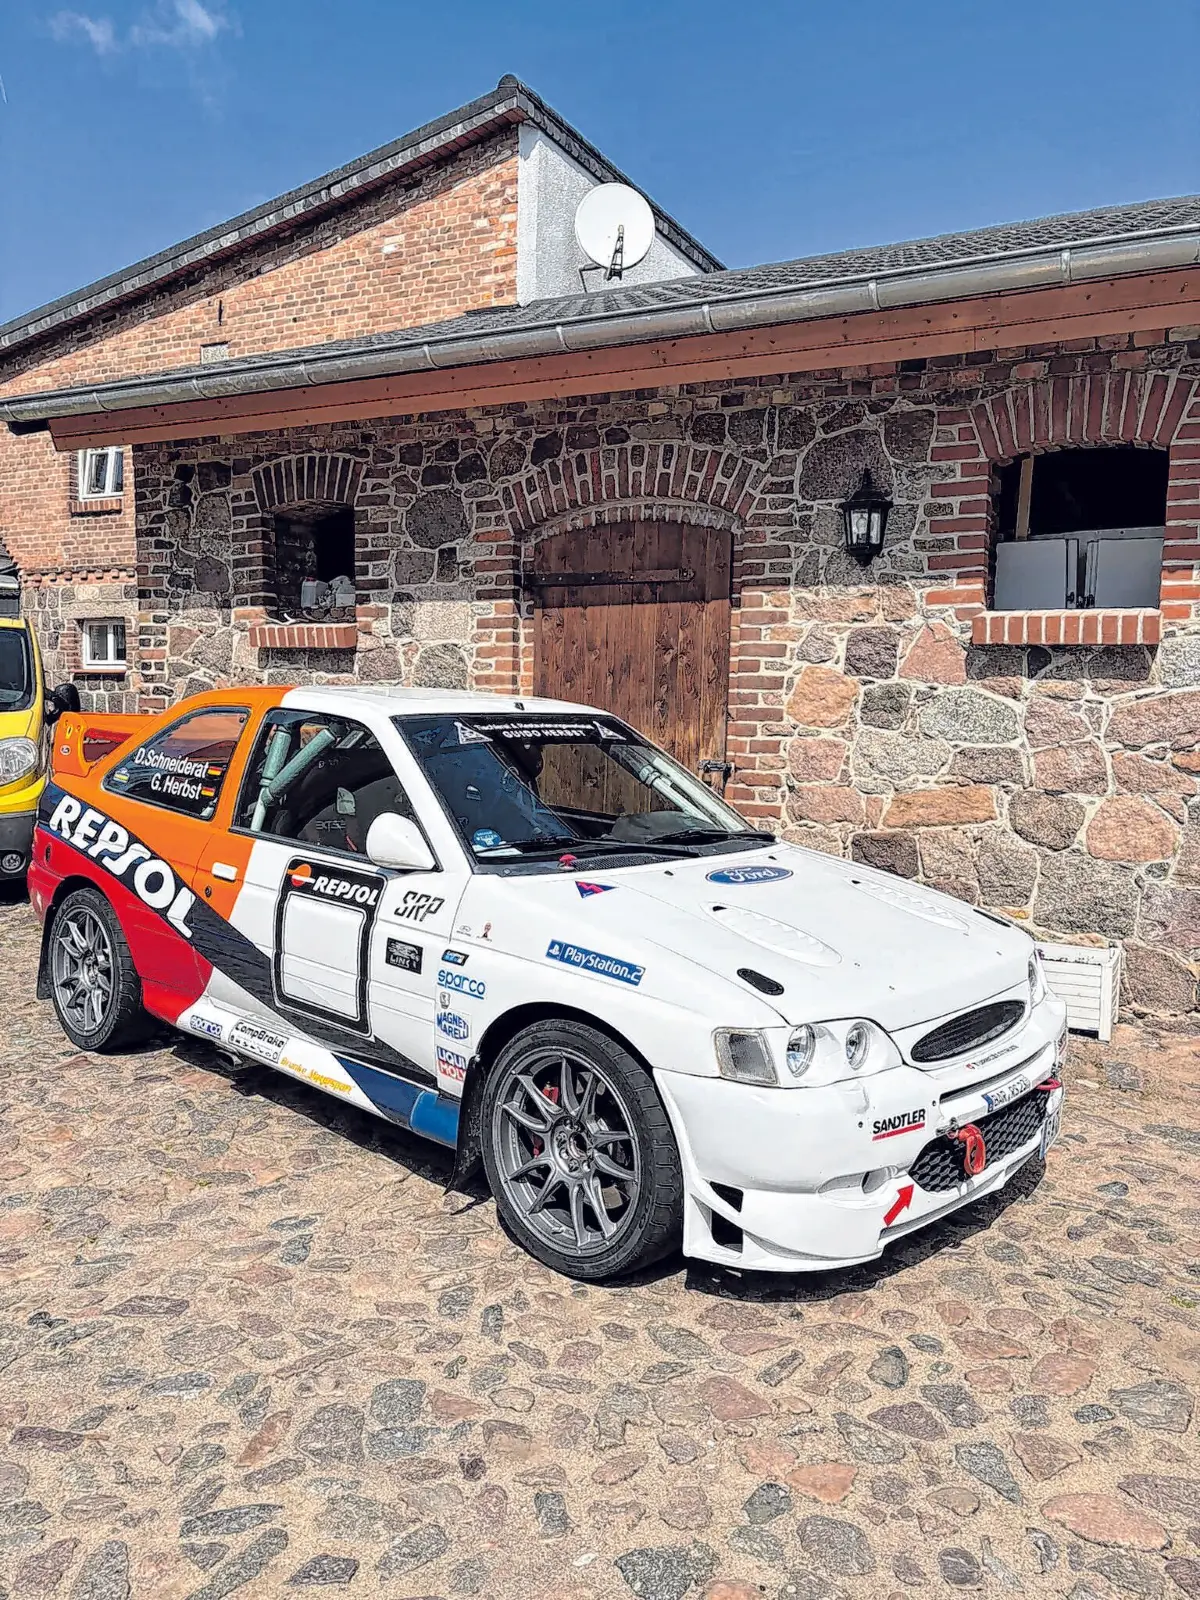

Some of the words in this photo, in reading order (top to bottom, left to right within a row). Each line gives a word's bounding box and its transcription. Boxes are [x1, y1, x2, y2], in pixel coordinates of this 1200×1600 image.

[502, 729, 542, 738] GUIDO
[545, 729, 587, 737] HERBST
[151, 772, 162, 791] G.
[163, 775, 202, 800] Herbst
[50, 795, 196, 938] REPSOL
[722, 866, 779, 882] Ford
[312, 876, 380, 906] REPSOL
[437, 969, 486, 996] sparco
[190, 1015, 222, 1037] sparco
[872, 1108, 926, 1135] SANDTLER
